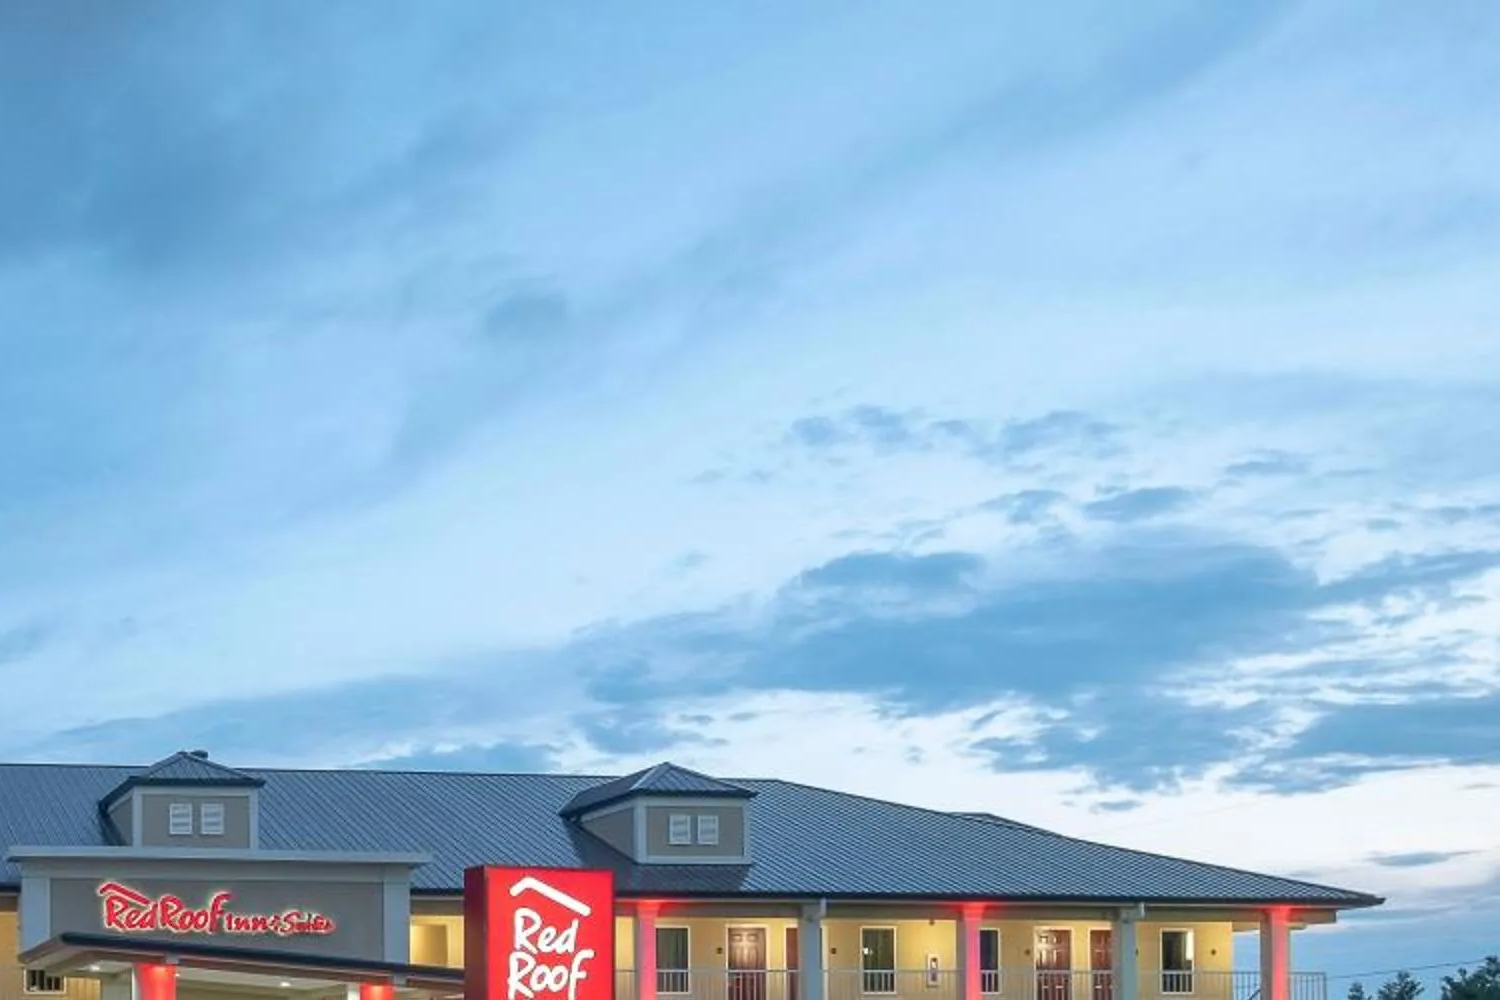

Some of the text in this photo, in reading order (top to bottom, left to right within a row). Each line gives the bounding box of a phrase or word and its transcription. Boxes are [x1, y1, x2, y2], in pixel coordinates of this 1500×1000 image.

[104, 894, 157, 931] Red
[158, 890, 231, 933] Roof
[513, 906, 580, 955] Red
[507, 949, 596, 1000] Roof
